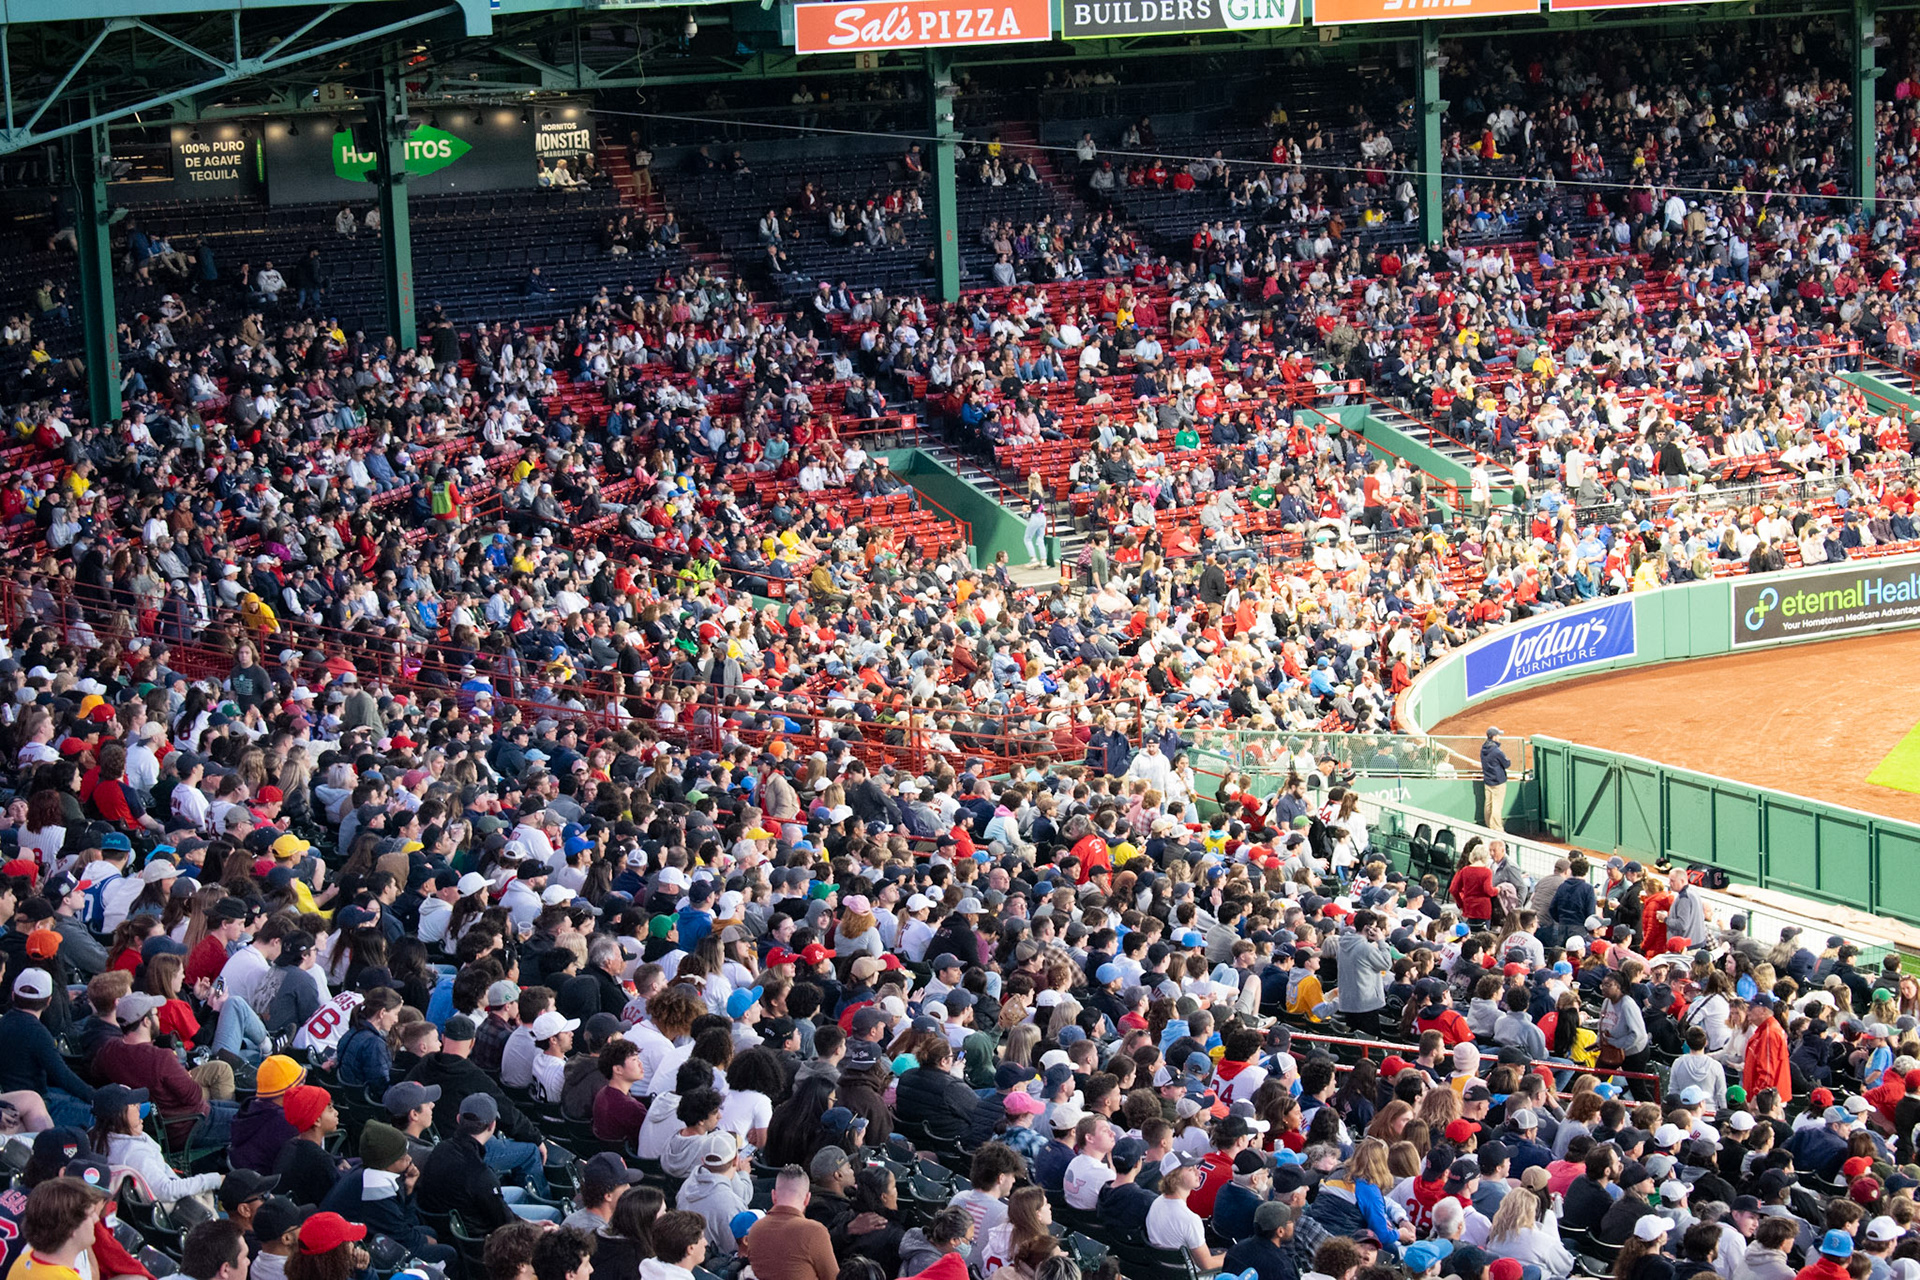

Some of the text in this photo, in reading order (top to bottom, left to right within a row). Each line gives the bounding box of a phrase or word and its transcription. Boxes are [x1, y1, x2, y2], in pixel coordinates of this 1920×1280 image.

[1074, 0, 1285, 25] BUILDERS GIN
[828, 6, 1021, 45] Sal's PIZZA
[1326, 29, 1333, 42] 7
[863, 54, 870, 68] 6
[328, 83, 336, 99] 5
[541, 122, 577, 131] HORNITOS
[180, 141, 245, 154] 100% PURO
[342, 139, 452, 164] HOITOS
[543, 149, 579, 158] MARGARITA
[185, 155, 241, 168] DE AGAVE
[189, 169, 239, 181] TEQUILA
[1783, 620, 1801, 630] Your
[1802, 615, 1845, 628] Hometown
[1845, 609, 1880, 622] Medicare
[1485, 617, 1607, 688] Jordan's
[1516, 647, 1597, 677] FURNITURE
[1364, 787, 1412, 800] NOLTA
